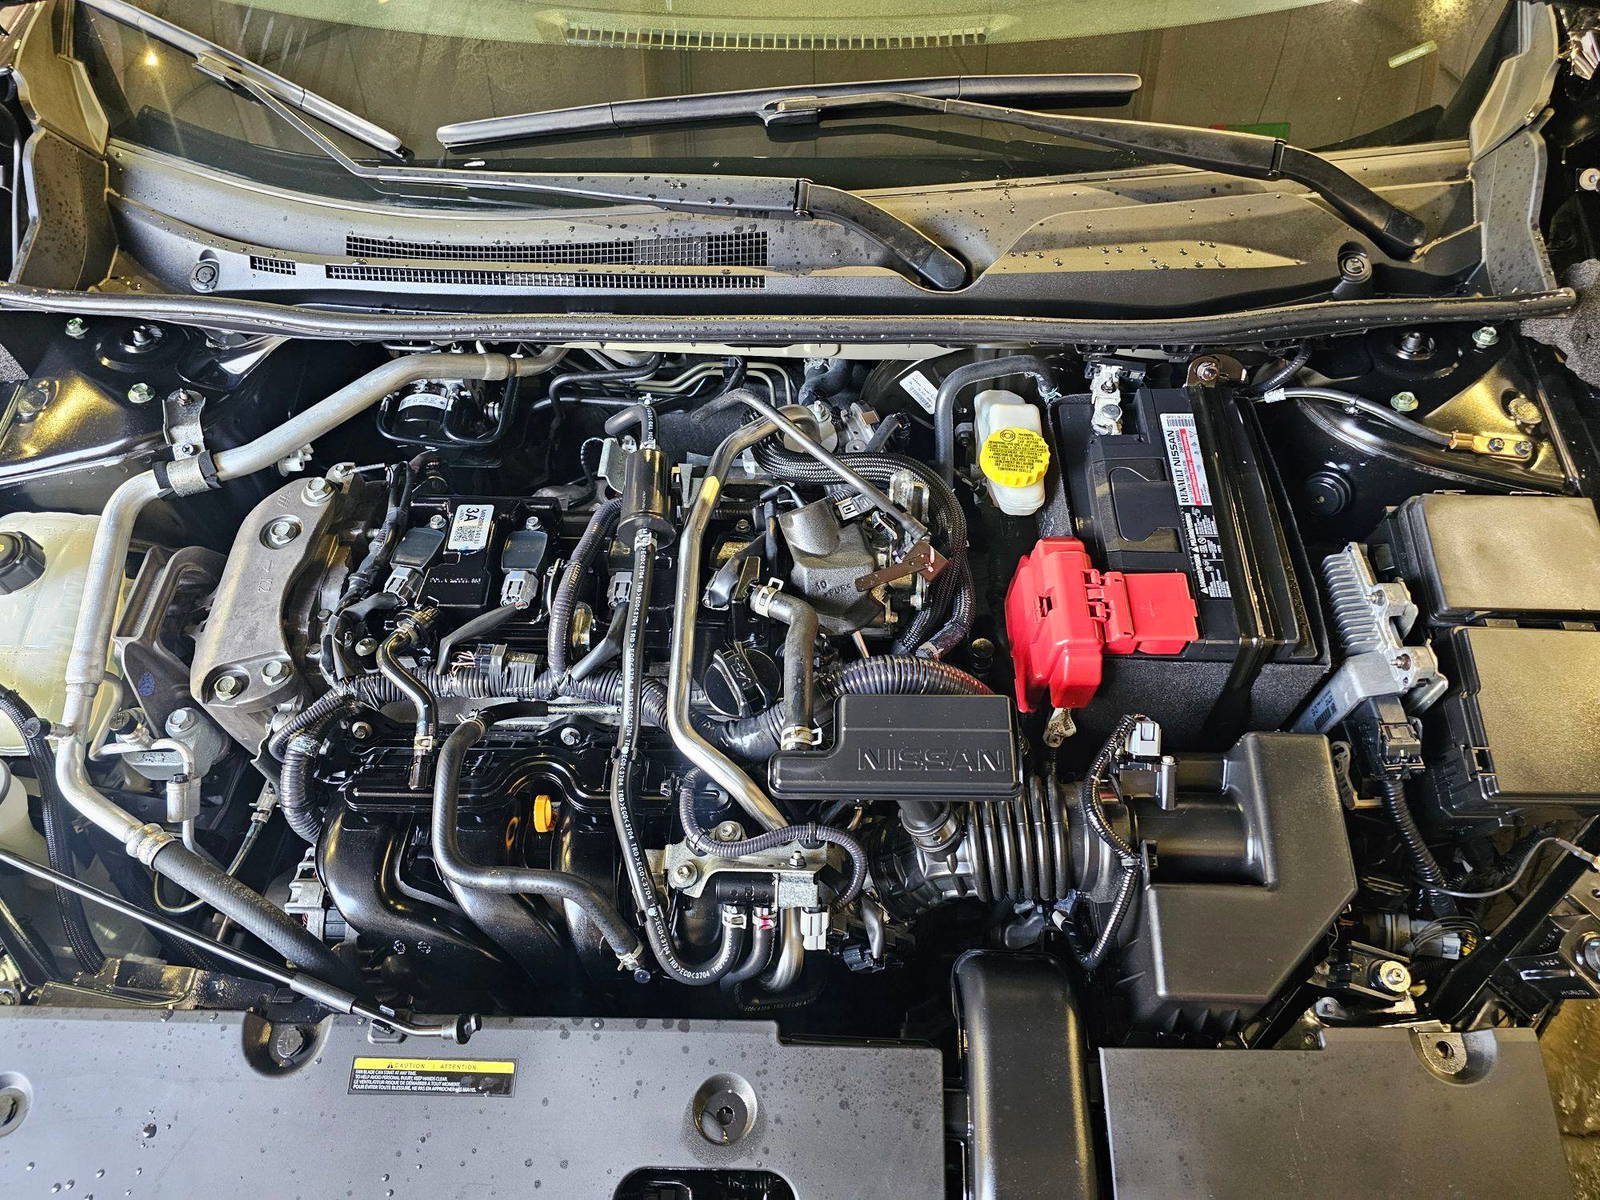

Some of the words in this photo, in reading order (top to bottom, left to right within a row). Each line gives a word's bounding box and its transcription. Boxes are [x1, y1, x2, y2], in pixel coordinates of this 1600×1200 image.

[1167, 430, 1180, 466] NISSAN
[1174, 466, 1189, 503] RENAULT
[465, 507, 478, 522] 3A
[858, 748, 1005, 771] NISSAN
[617, 739, 631, 786] TRECO<3704
[650, 900, 671, 955] T>ECO<3704
